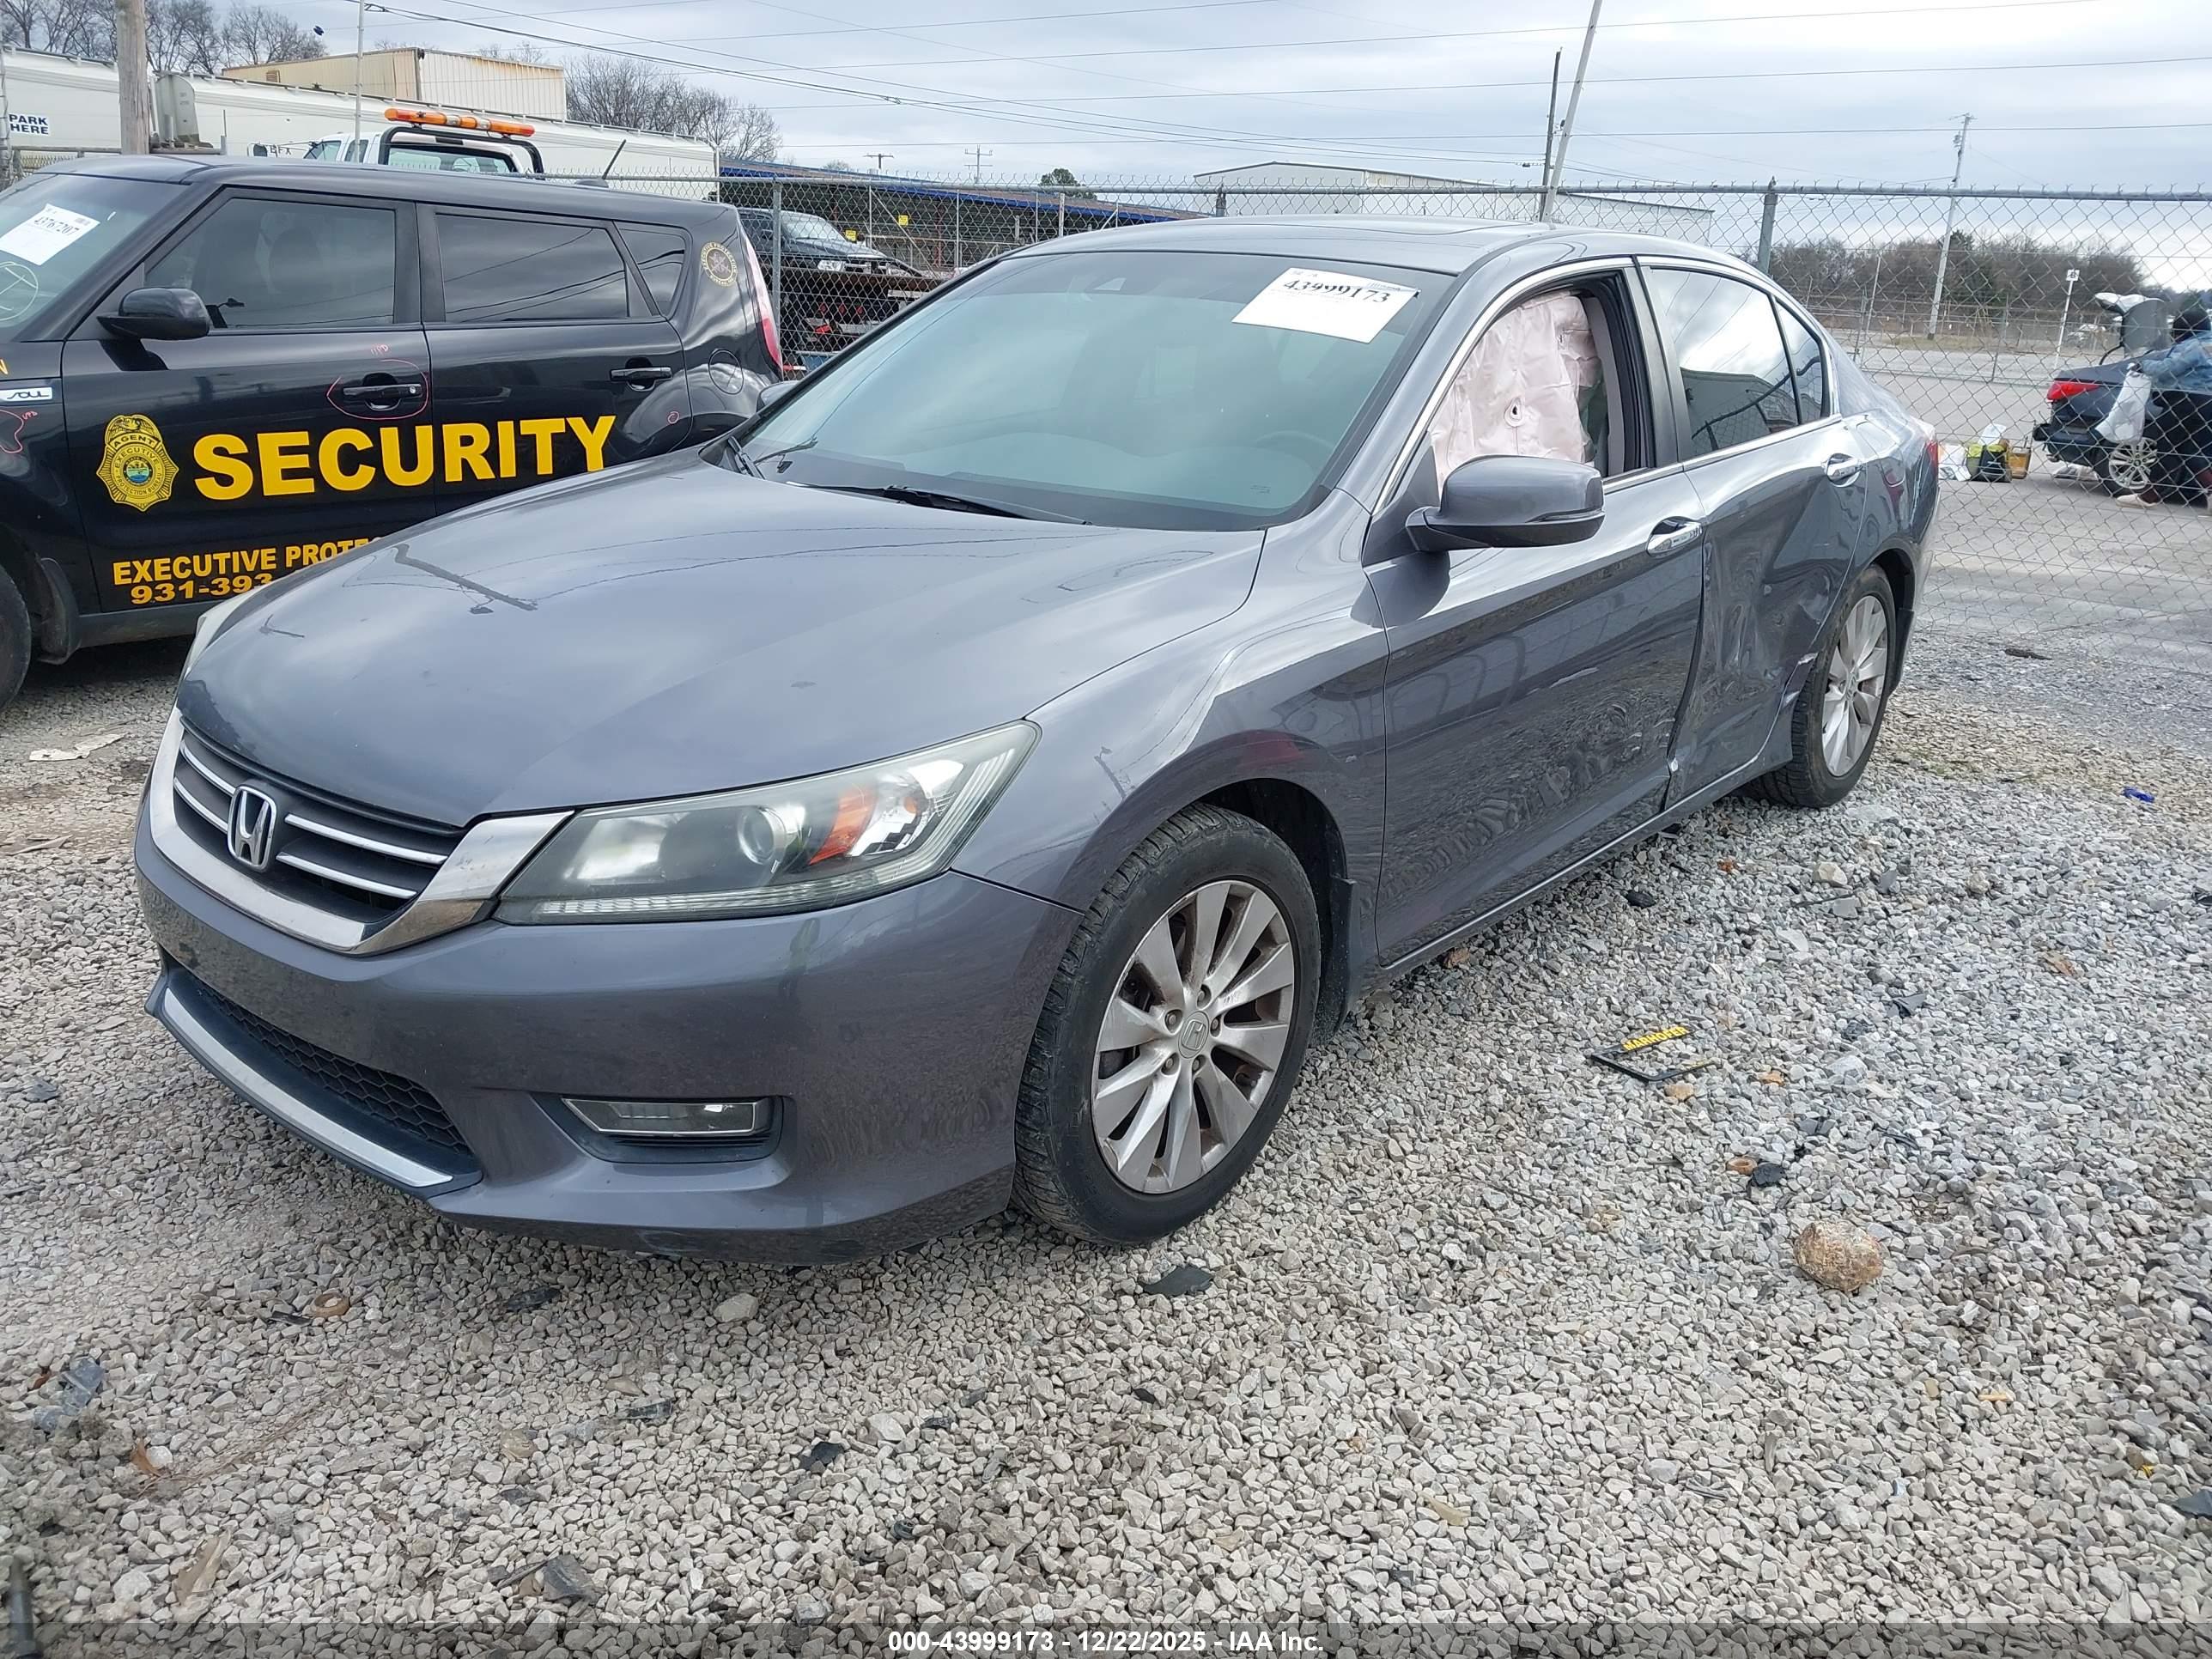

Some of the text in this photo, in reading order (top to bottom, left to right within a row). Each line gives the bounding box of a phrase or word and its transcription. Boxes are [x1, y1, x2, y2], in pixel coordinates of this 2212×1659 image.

[9, 113, 48, 125] PARK
[10, 123, 49, 135] HERE
[1284, 279, 1391, 303] 43999173
[113, 434, 154, 447] AGENT
[114, 447, 159, 469] EXECUTIVE
[193, 415, 617, 501] SECURITY
[112, 548, 277, 586] EXECUTIVE
[1622, 1026, 1689, 1051] MARHOFER
